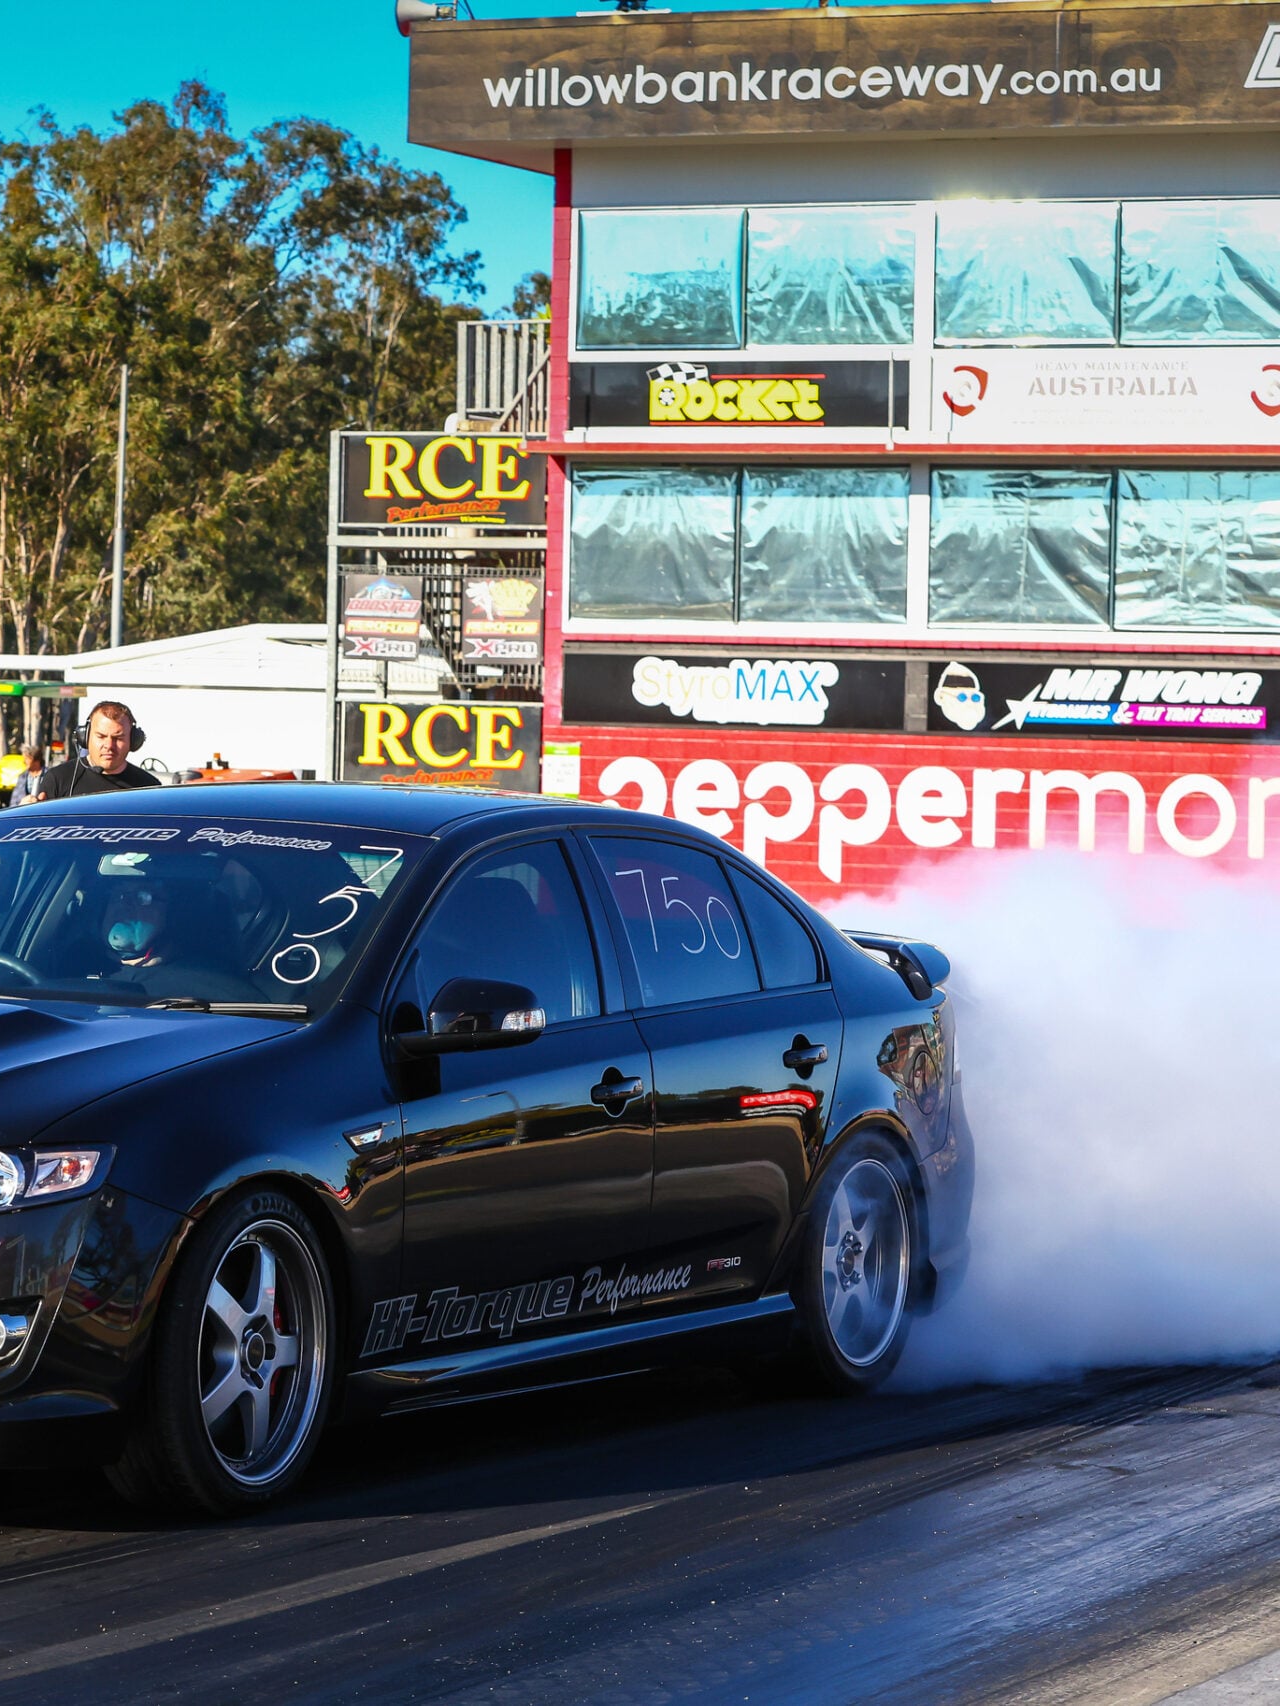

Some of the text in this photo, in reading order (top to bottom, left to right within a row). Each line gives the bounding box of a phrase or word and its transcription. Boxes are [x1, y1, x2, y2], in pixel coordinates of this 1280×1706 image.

[482, 62, 1161, 108] willowbankraceway.com.au
[1027, 376, 1199, 397] AUSTRALIA
[363, 436, 532, 499] RCE
[386, 499, 501, 523] Performance
[640, 664, 820, 708] StyroMAX
[1039, 668, 1263, 705] MR WONG
[1112, 702, 1135, 725] &
[358, 703, 525, 769] RCE
[187, 828, 334, 851] Performance
[615, 868, 741, 960] 750
[359, 1262, 692, 1358] Hi-Torque Performance
